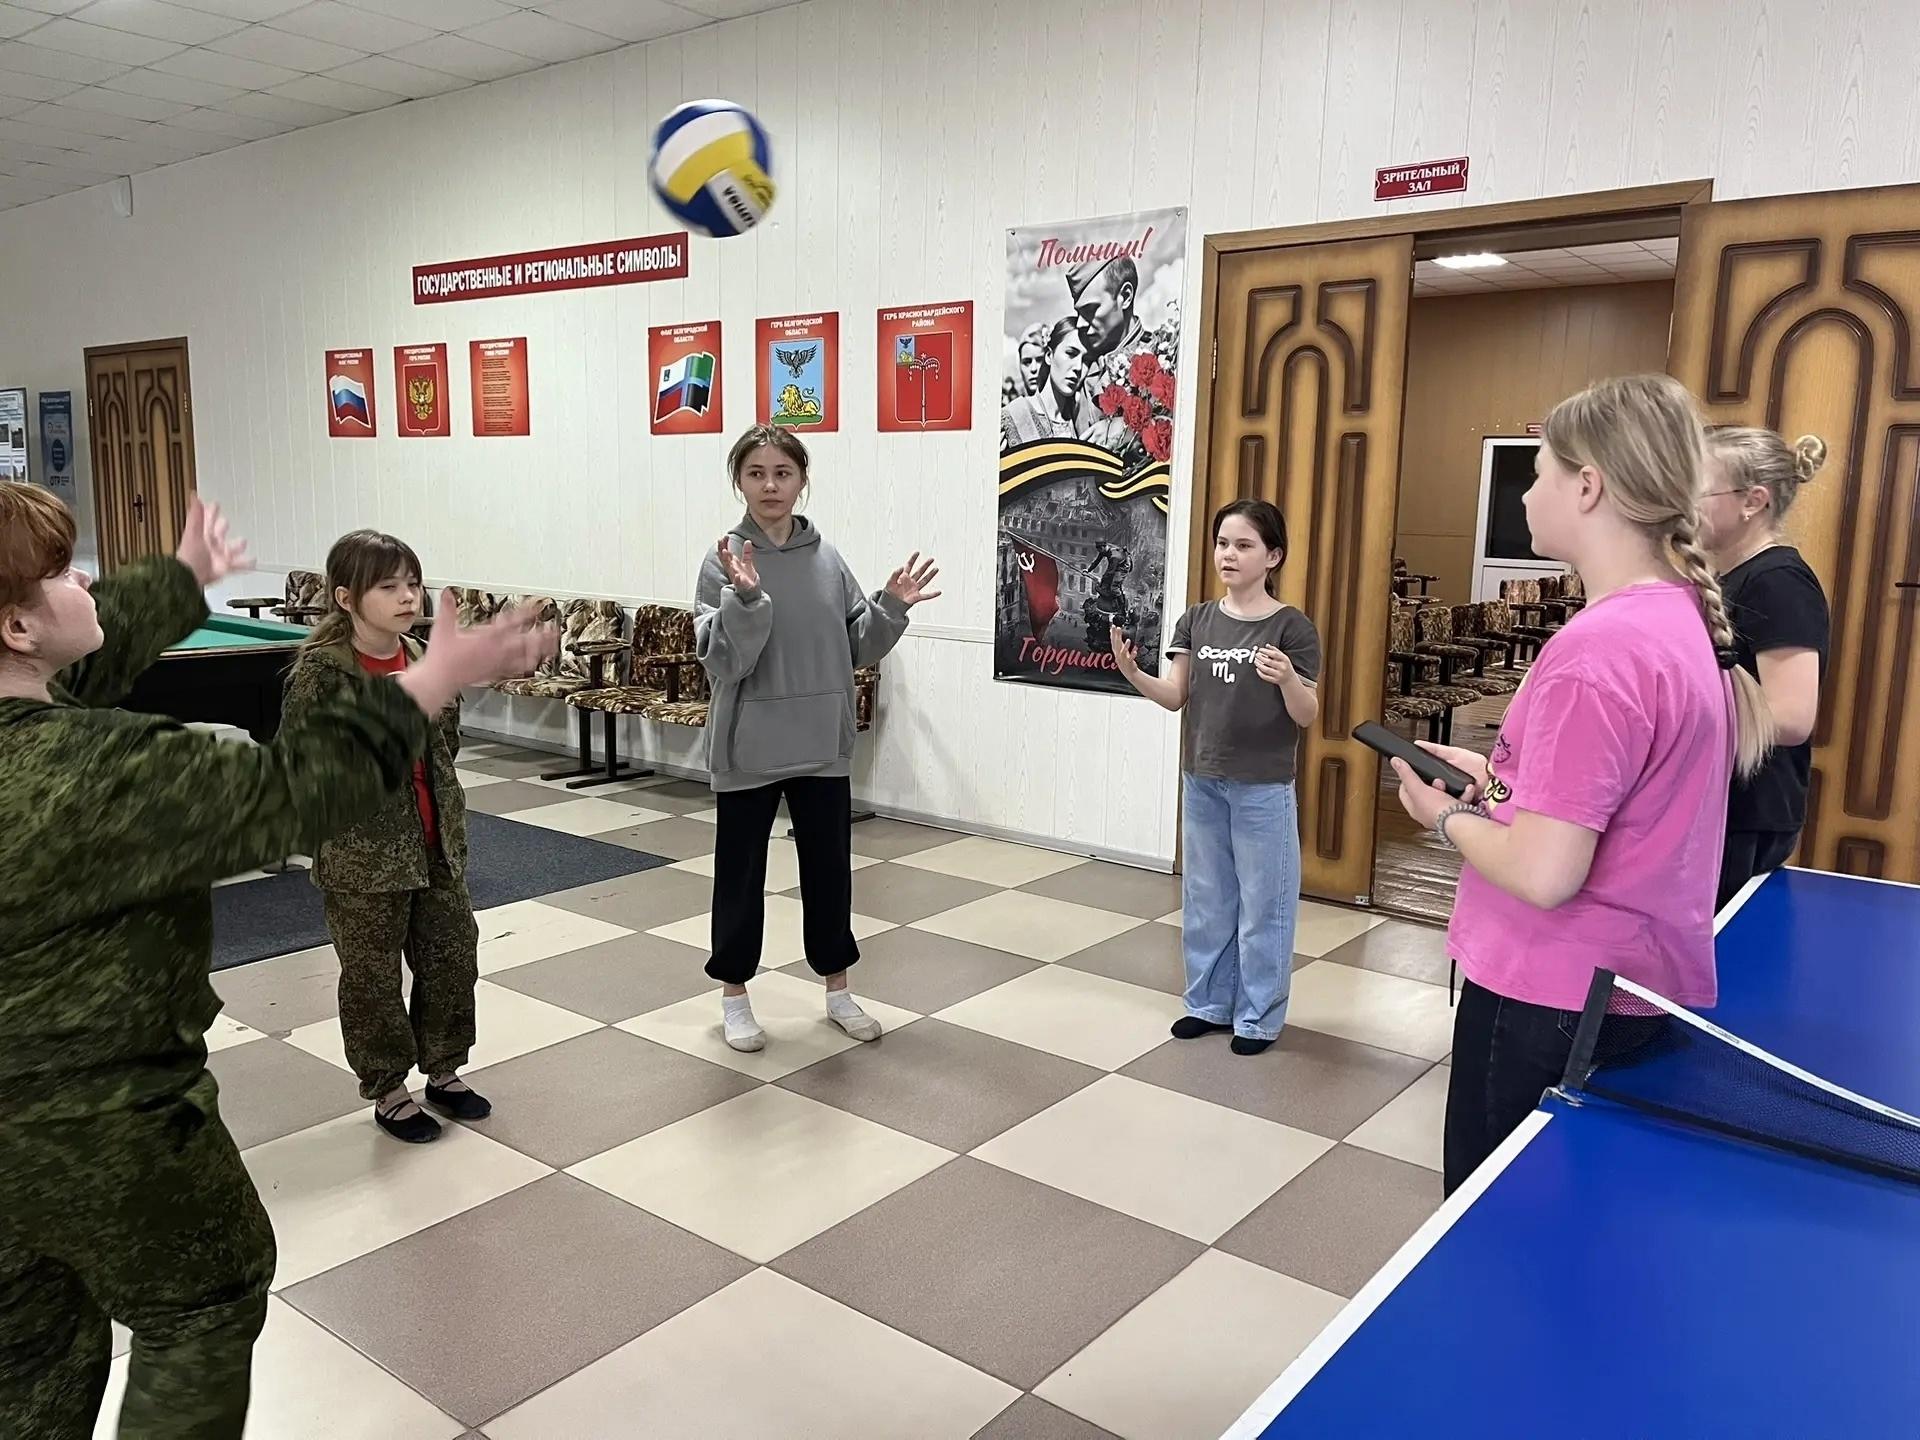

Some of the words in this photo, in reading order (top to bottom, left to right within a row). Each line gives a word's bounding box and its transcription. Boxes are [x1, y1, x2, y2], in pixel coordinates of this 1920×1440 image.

[1382, 162, 1460, 183] ЗРИТЕЛЬНЫЙ
[1407, 180, 1432, 193] ЗАЛ
[1037, 227, 1153, 268] Помним!
[417, 265, 512, 296] ГОСУДАРСТВЕННЫЕ
[514, 263, 523, 285] И
[525, 253, 615, 283] РЕГИОНАЛЬНЫЕ
[616, 244, 681, 273] СИМВОЛЫ
[898, 305, 965, 319] КРАСНОГВАРДЕЙСКОГО
[911, 319, 935, 328] РАЙОНА
[1018, 637, 1138, 675] Гордимс
